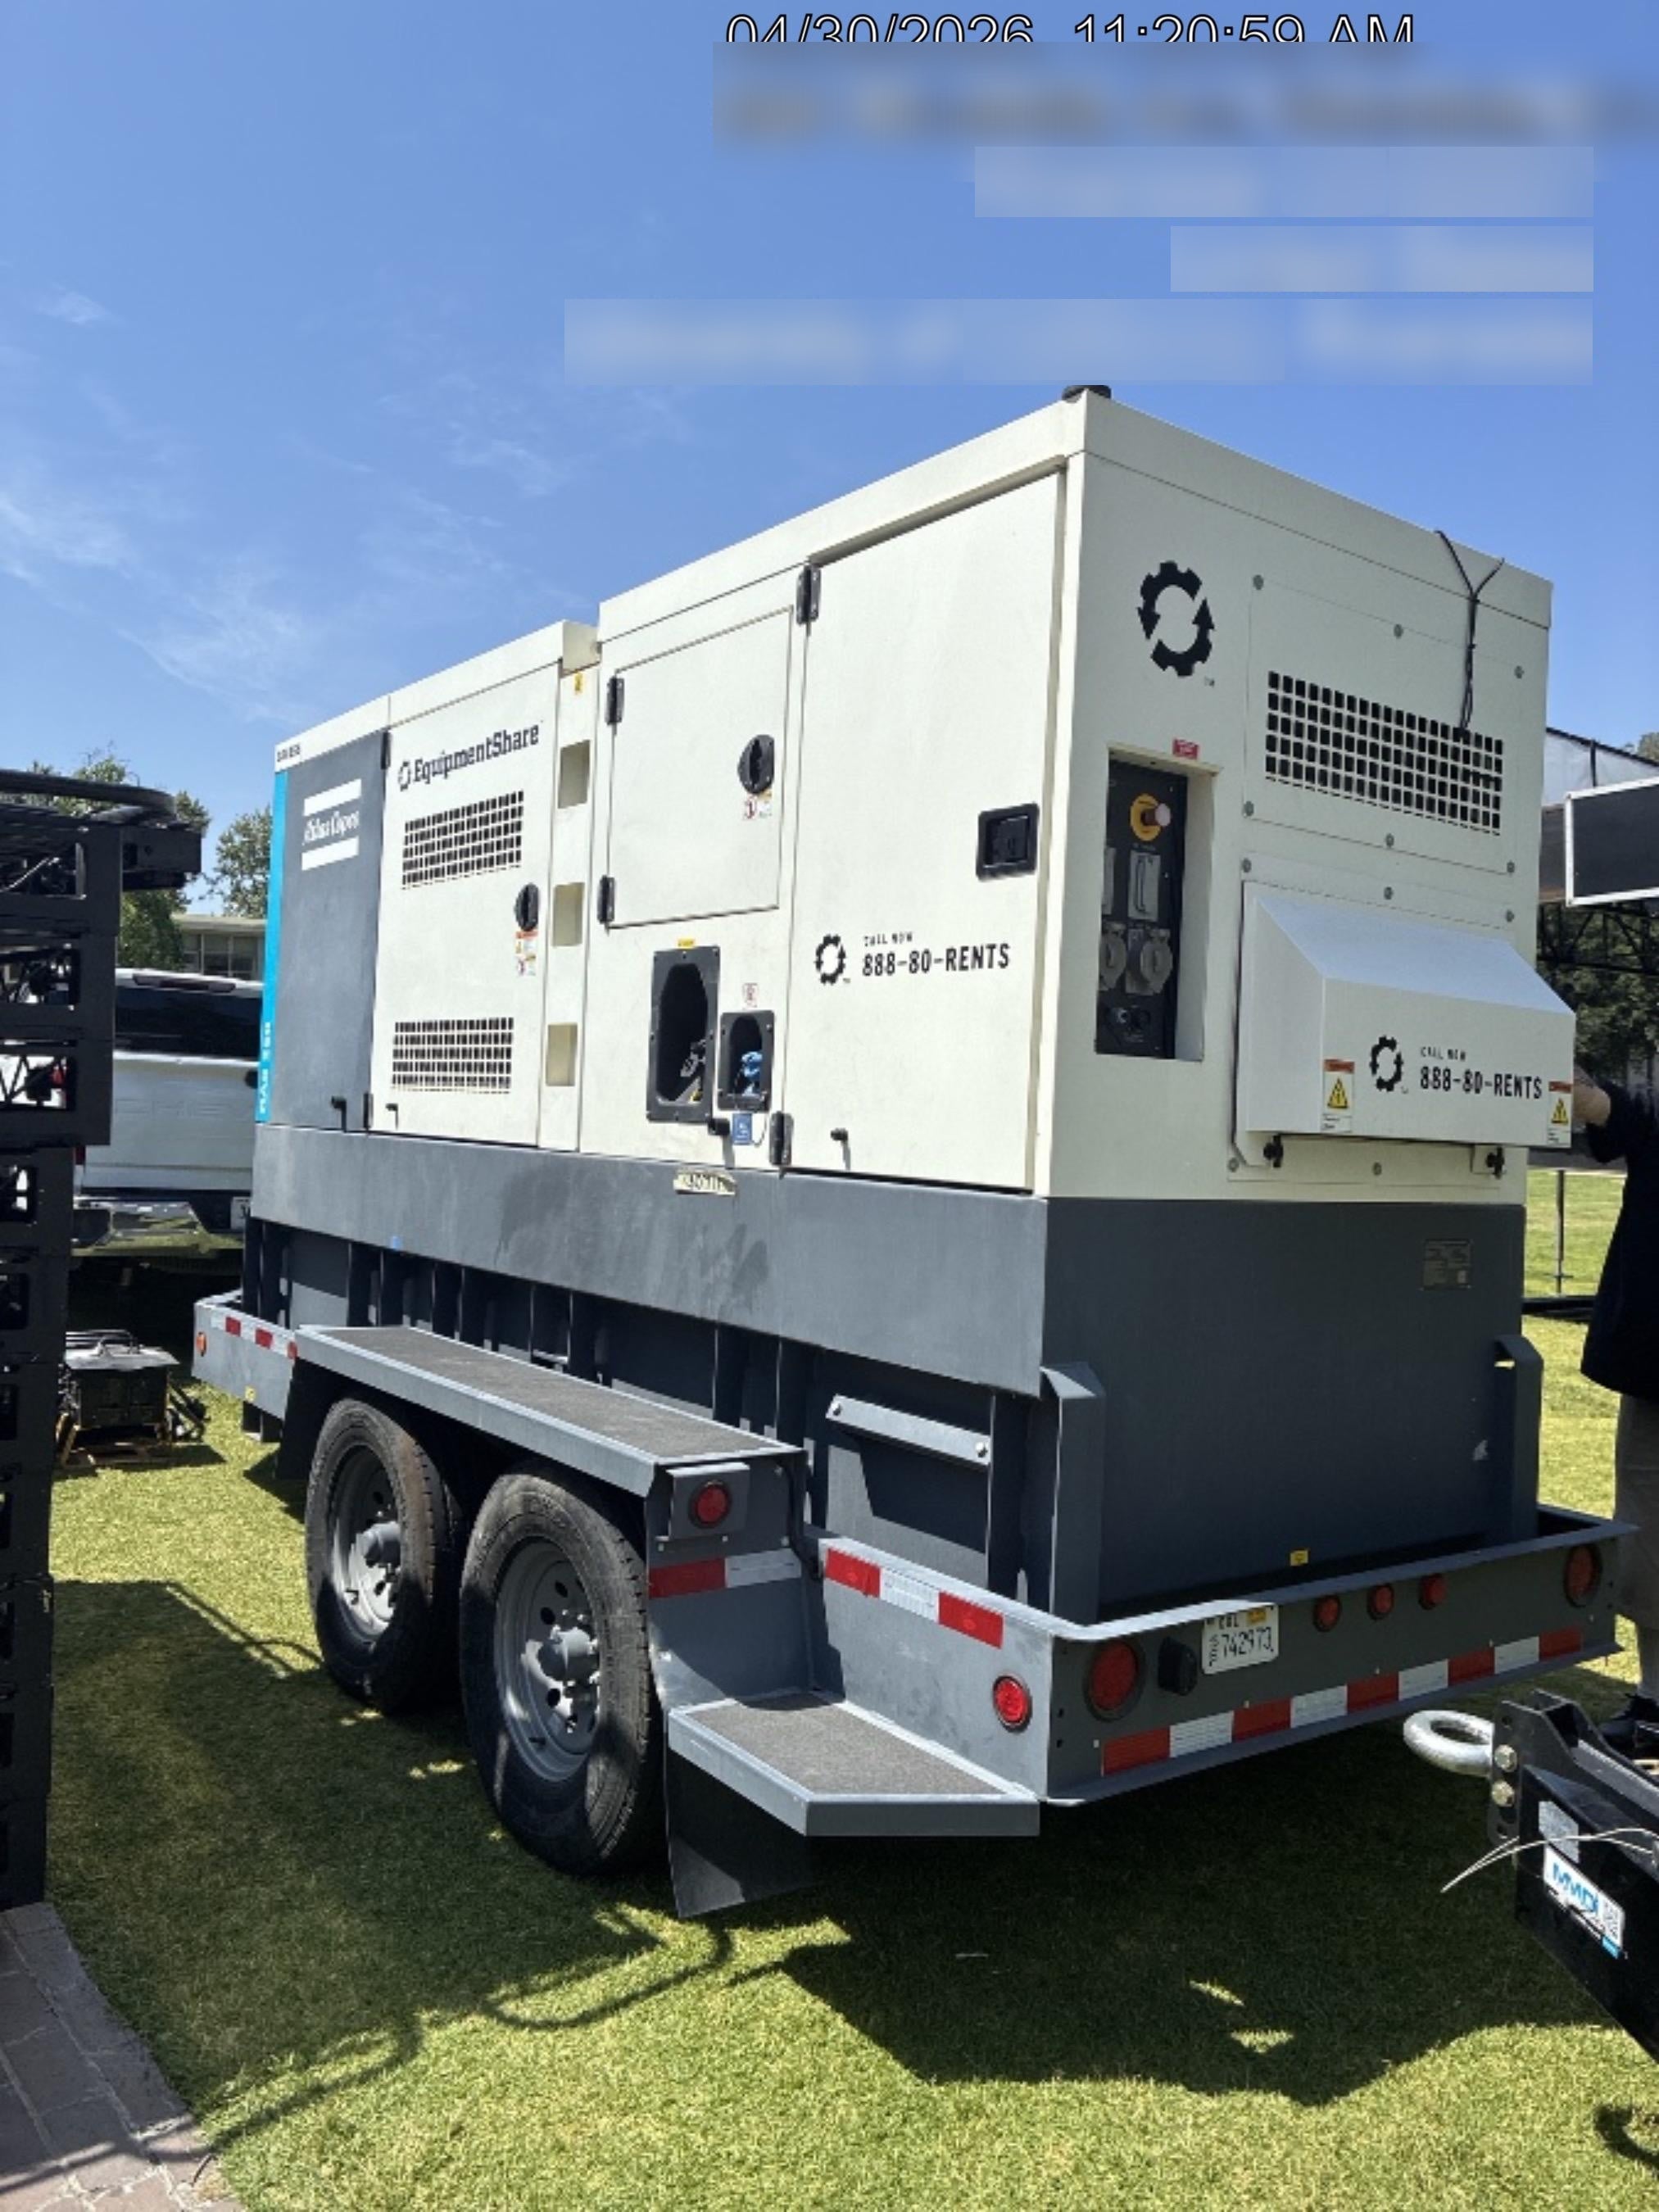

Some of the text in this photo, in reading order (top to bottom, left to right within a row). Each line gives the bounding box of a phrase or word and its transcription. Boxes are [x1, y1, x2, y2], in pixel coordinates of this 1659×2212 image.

[413, 724, 540, 785] EquipmentShare
[862, 942, 1012, 977] 888-80-RENTS
[1420, 1065, 1543, 1100] 888-80-RENTS
